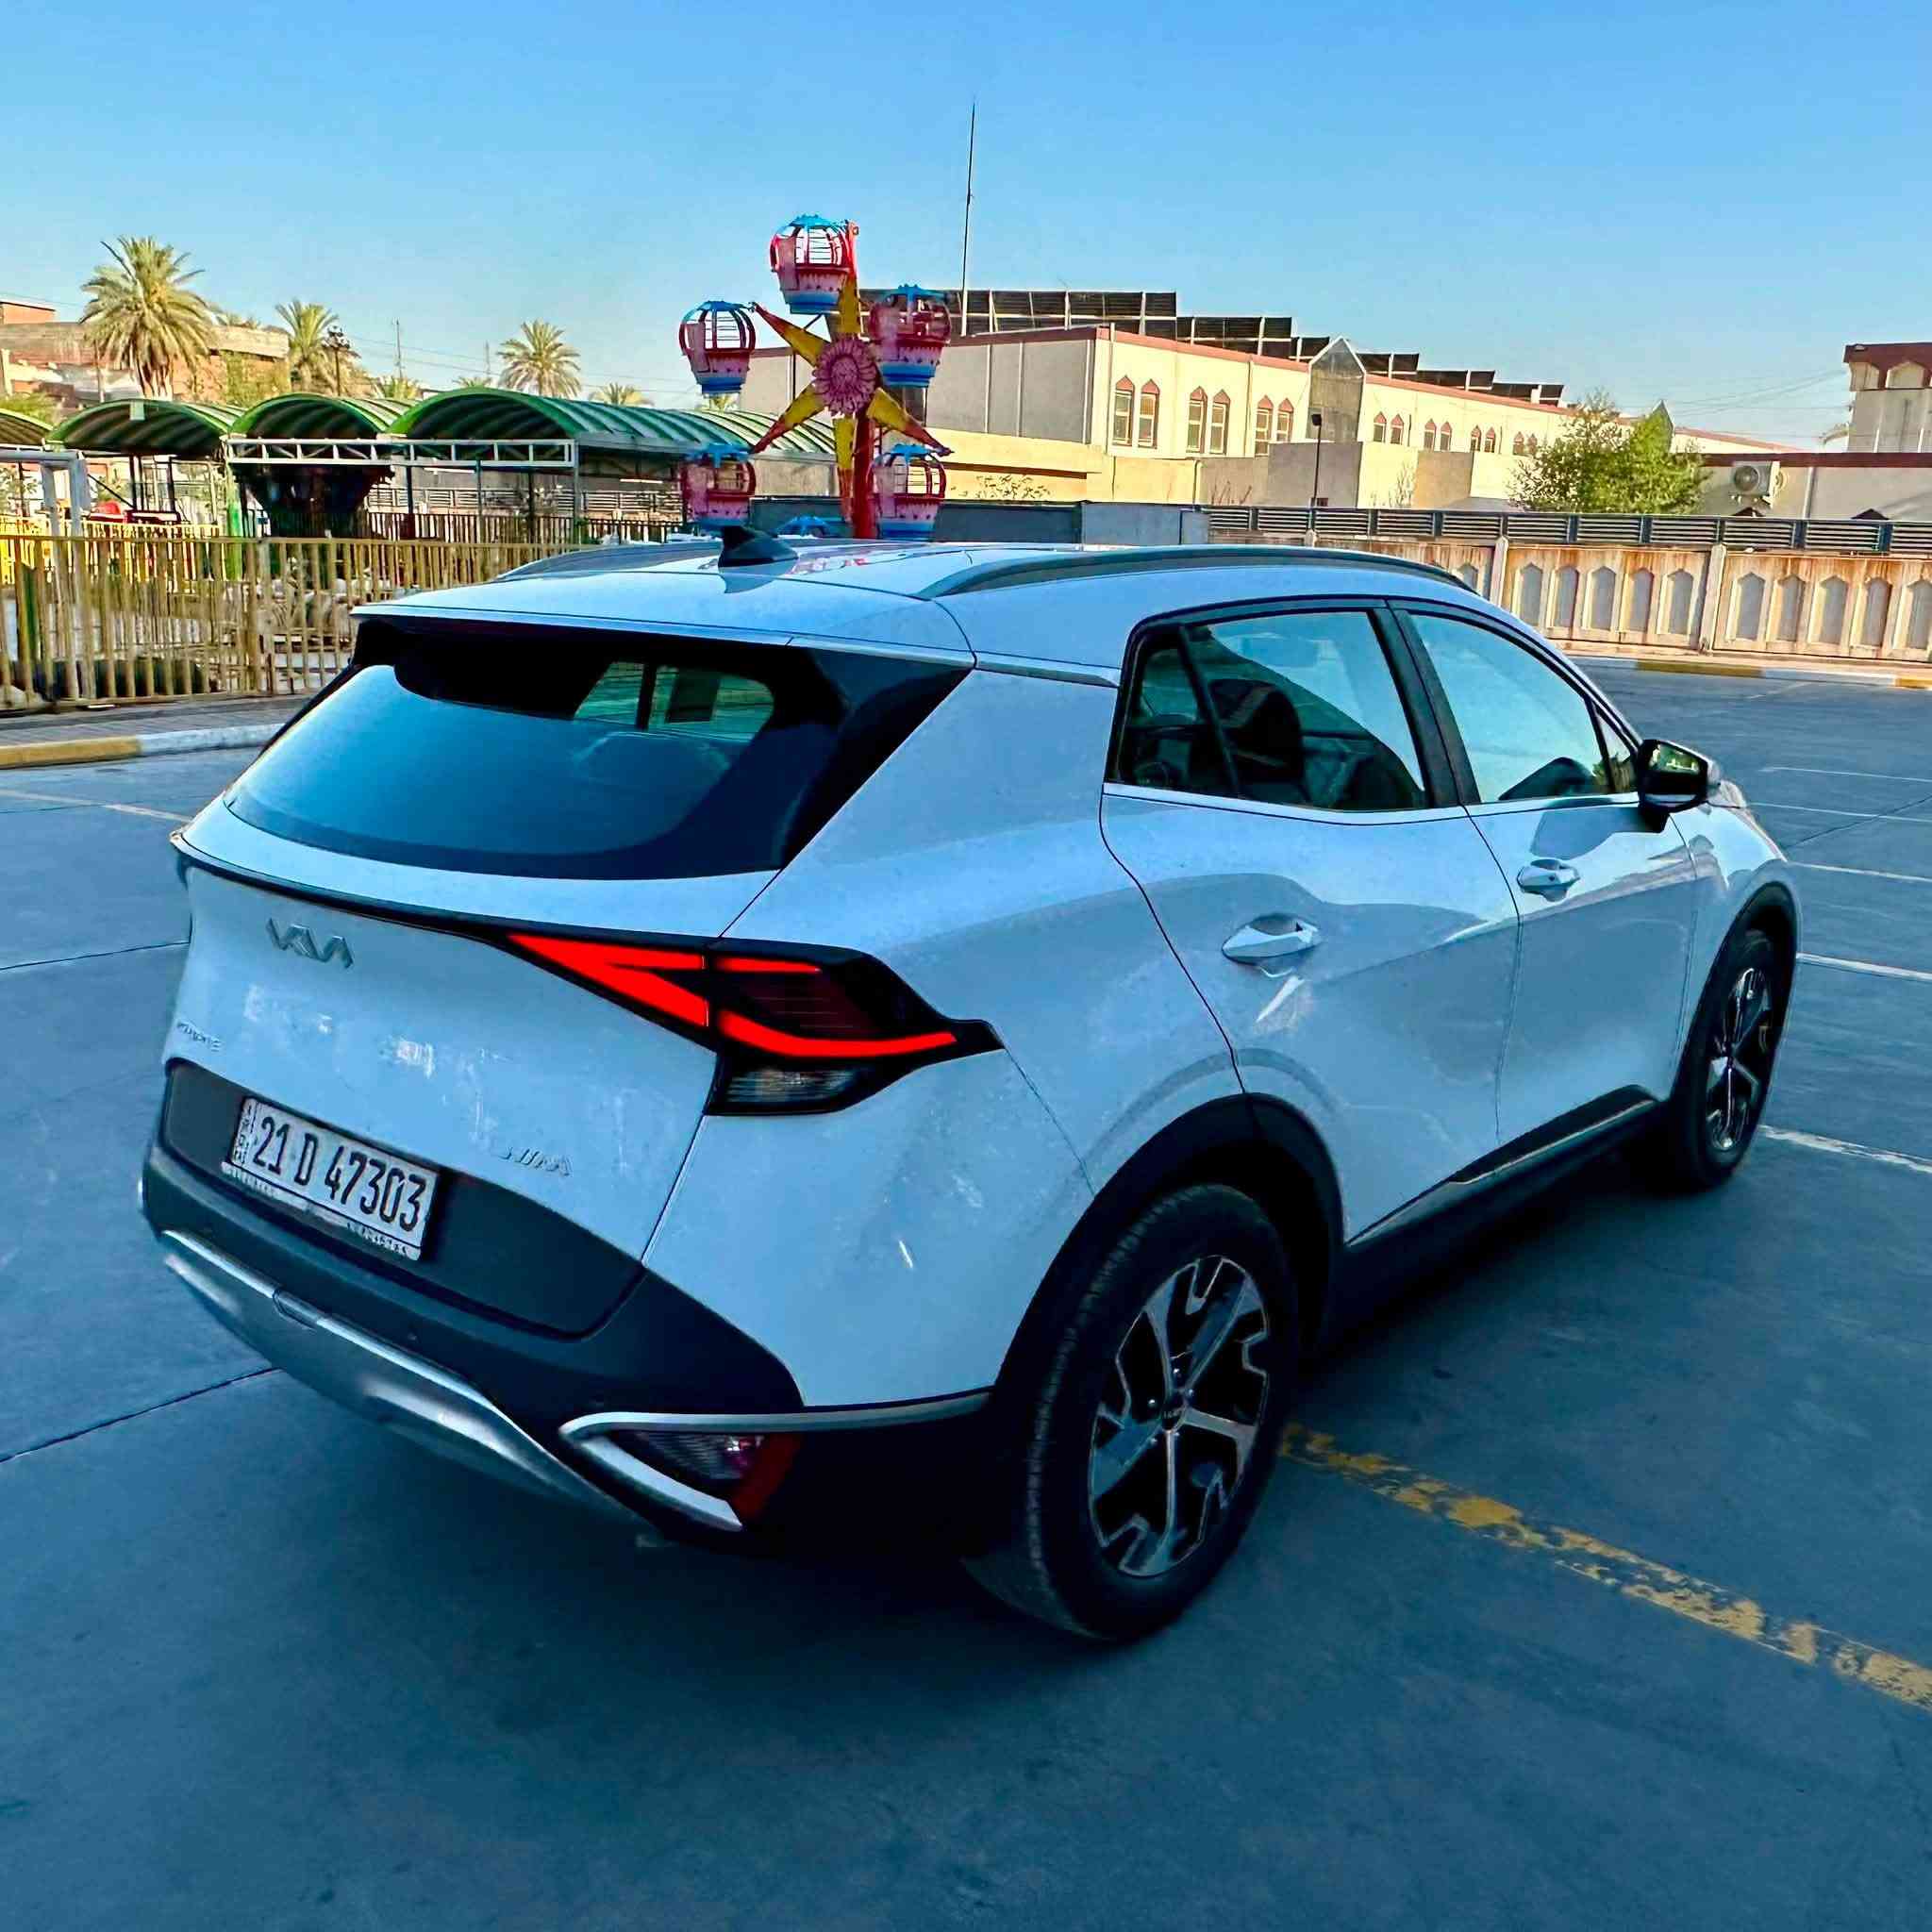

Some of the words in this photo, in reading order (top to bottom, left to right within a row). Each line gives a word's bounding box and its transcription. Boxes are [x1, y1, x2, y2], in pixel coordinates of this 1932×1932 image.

[253, 1116, 289, 1174] 21
[294, 1133, 318, 1186] D
[325, 1145, 426, 1232] 47303
